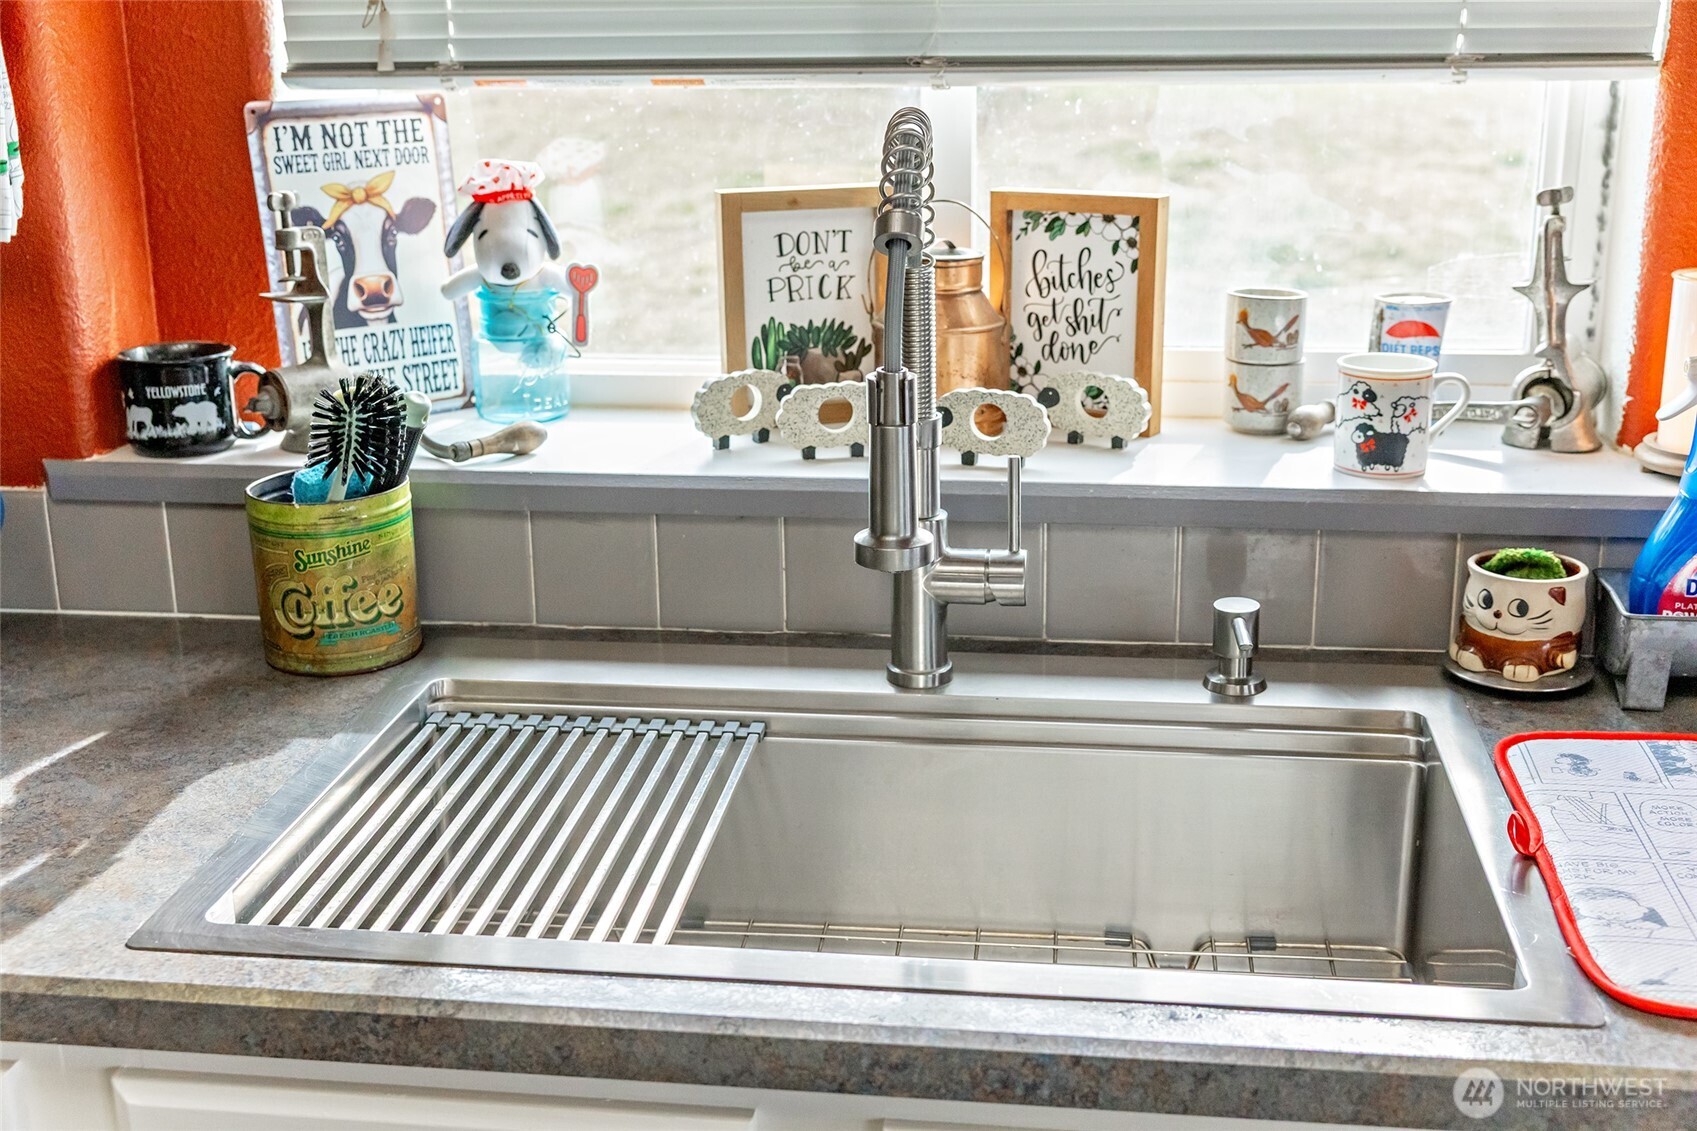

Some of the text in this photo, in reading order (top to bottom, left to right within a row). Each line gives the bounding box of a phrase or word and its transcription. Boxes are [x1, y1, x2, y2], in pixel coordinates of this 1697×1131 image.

[273, 117, 424, 153] I'M NOT THE
[273, 146, 430, 175] SWEET GIRL NEXT DOOR
[773, 228, 853, 258] DON'T
[778, 255, 850, 273] be a
[1025, 246, 1125, 299] bitches
[766, 273, 856, 304] PRICK
[1023, 293, 1123, 342] get shit
[362, 328, 406, 364] CRAZY
[409, 323, 456, 357] HEIFER
[1041, 330, 1122, 365] done
[1381, 342, 1407, 353] DIET
[145, 382, 208, 399] YELLOWSTONE
[402, 358, 460, 394] STREET
[293, 538, 371, 573] Sunshine
[269, 575, 404, 640] Coffee
